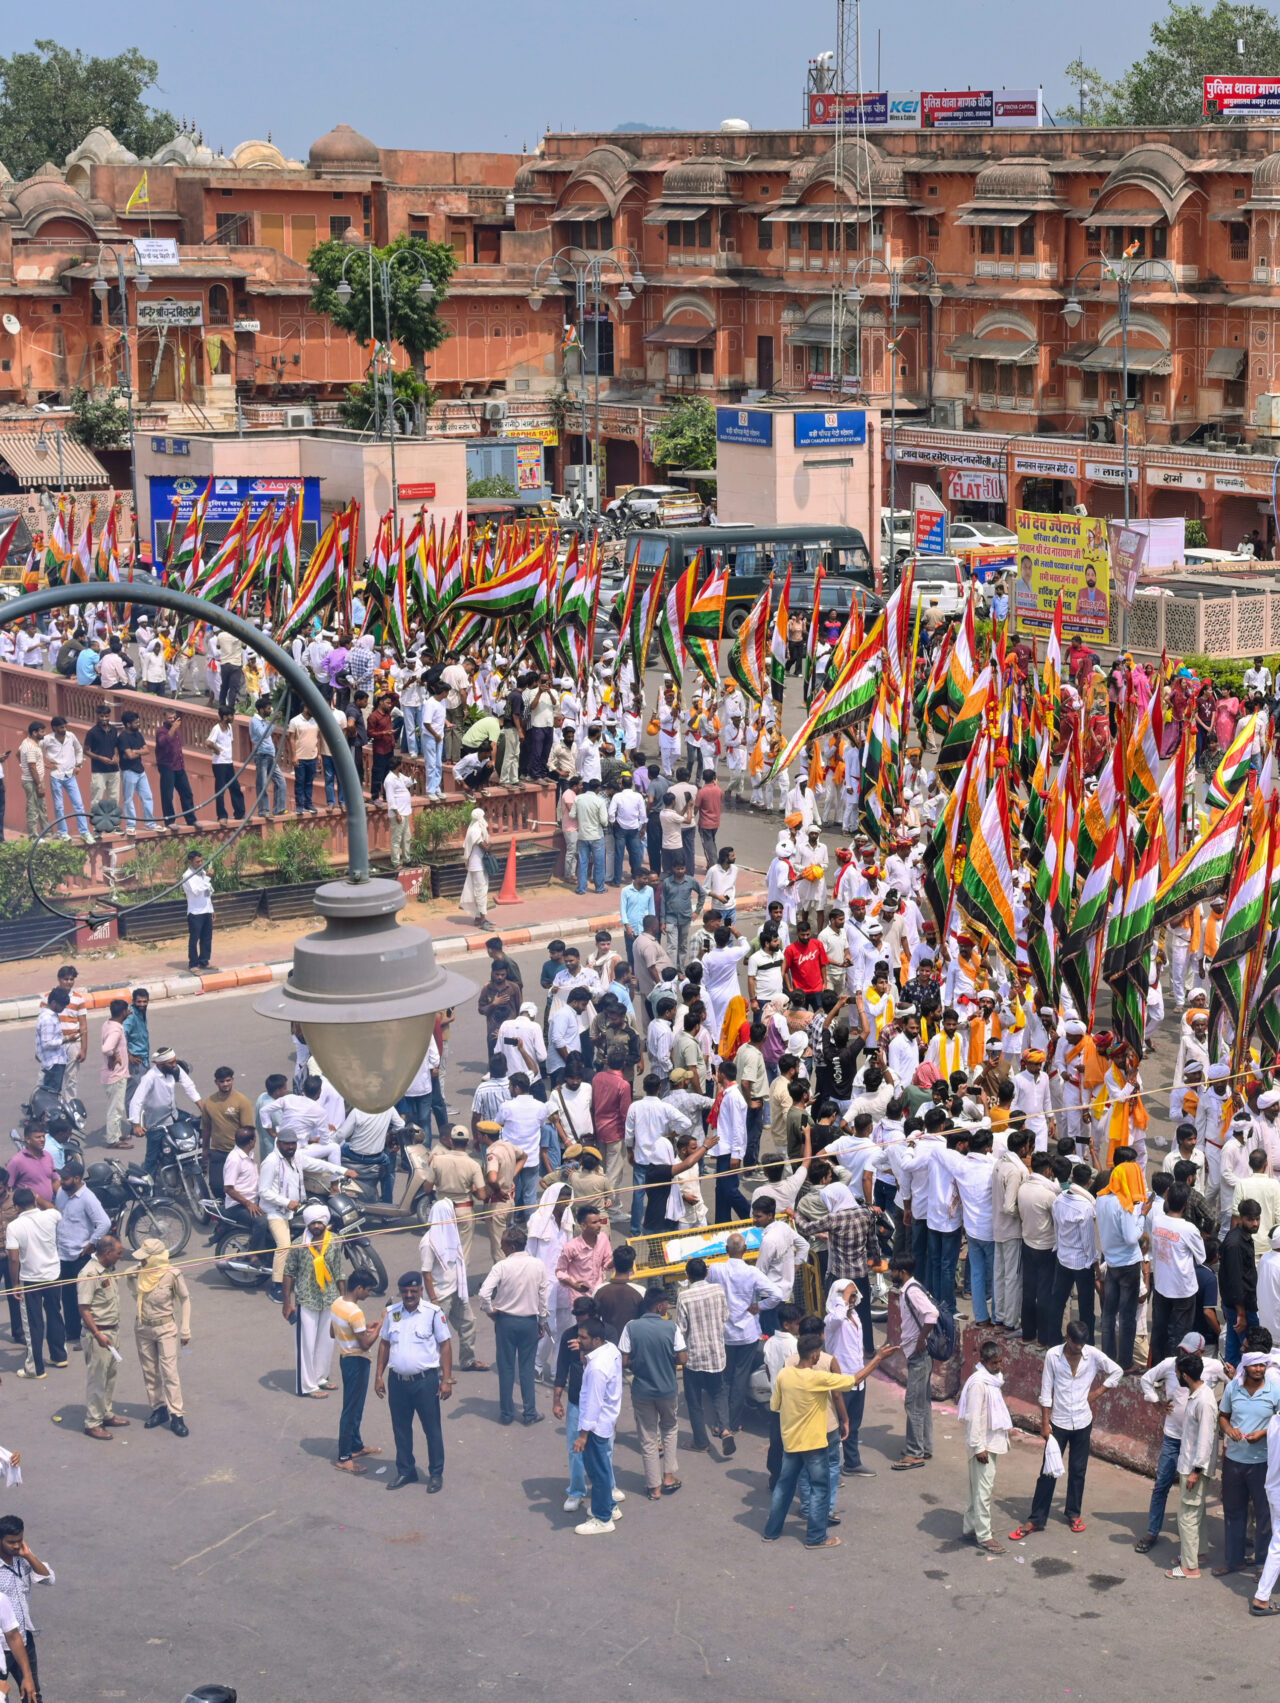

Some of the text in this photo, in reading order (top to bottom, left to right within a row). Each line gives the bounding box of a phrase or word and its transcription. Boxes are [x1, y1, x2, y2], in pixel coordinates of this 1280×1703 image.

[1207, 79, 1233, 98] पुलिस
[1235, 83, 1257, 95] थाना
[889, 100, 919, 113] KEI
[923, 94, 941, 112] पुलिस
[942, 97, 957, 108] थाना
[978, 92, 991, 108] चौक
[1163, 472, 1183, 484] शर्मा
[953, 482, 982, 499] FLAT
[1018, 513, 1081, 536] श्री देव ज्वैलर्स
